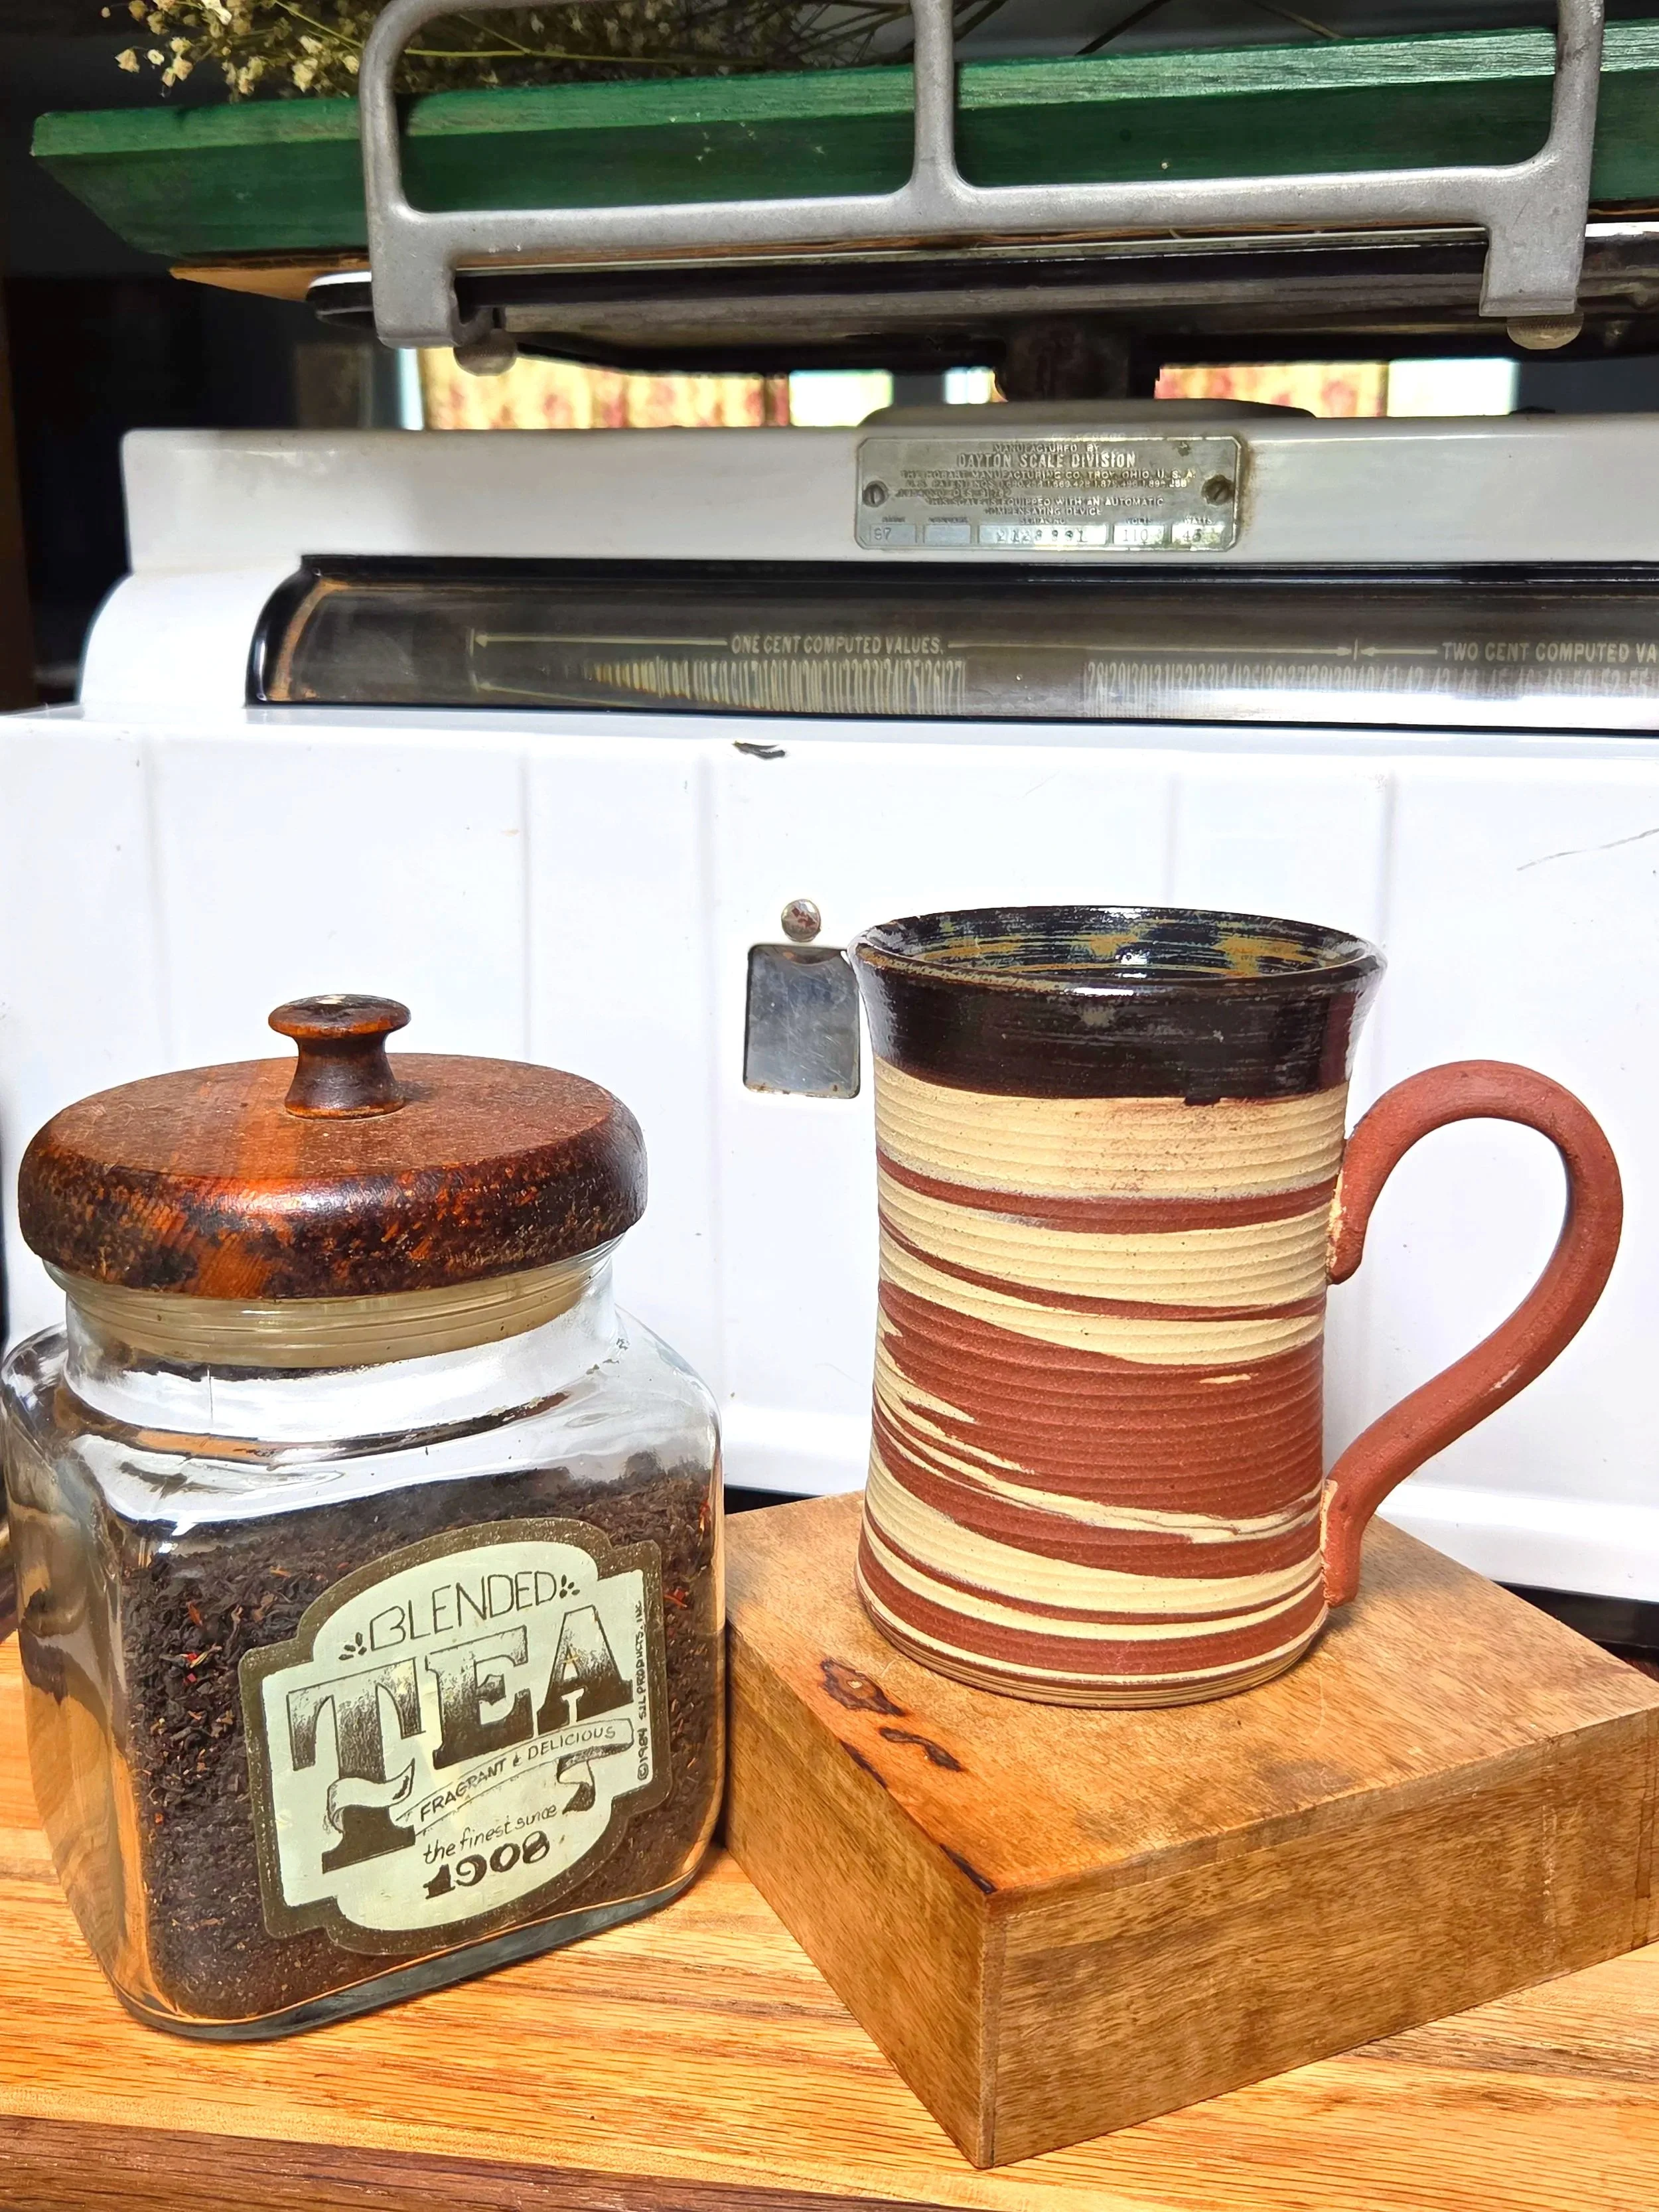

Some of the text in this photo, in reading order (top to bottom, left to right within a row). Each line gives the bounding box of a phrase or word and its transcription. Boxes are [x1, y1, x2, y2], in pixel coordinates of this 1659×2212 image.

[1086, 443, 1100, 453] BY
[957, 453, 1136, 469] DAYTON SCALE DIVISION
[972, 470, 1061, 479] MANUFACTURING
[1000, 498, 1051, 506] EQUIPPED
[1056, 497, 1082, 506] WITH
[1086, 498, 1101, 506] AN
[1104, 497, 1165, 506] AUTOMATIC
[1066, 507, 1102, 516] DEVICE
[731, 634, 760, 654] ONE
[763, 634, 802, 654] CENT
[803, 635, 882, 654] COMPUTED
[1442, 642, 1479, 662] TWO
[1484, 642, 1530, 662] CENT
[1535, 642, 1630, 663] COMPUTED
[369, 1571, 557, 1651] BLENDED
[286, 1604, 634, 1874] TEA
[419, 1726, 616, 1822] FRAGRANT & DELICIOUS
[423, 1804, 557, 1864] the finest since
[422, 1830, 551, 1900] 1908
